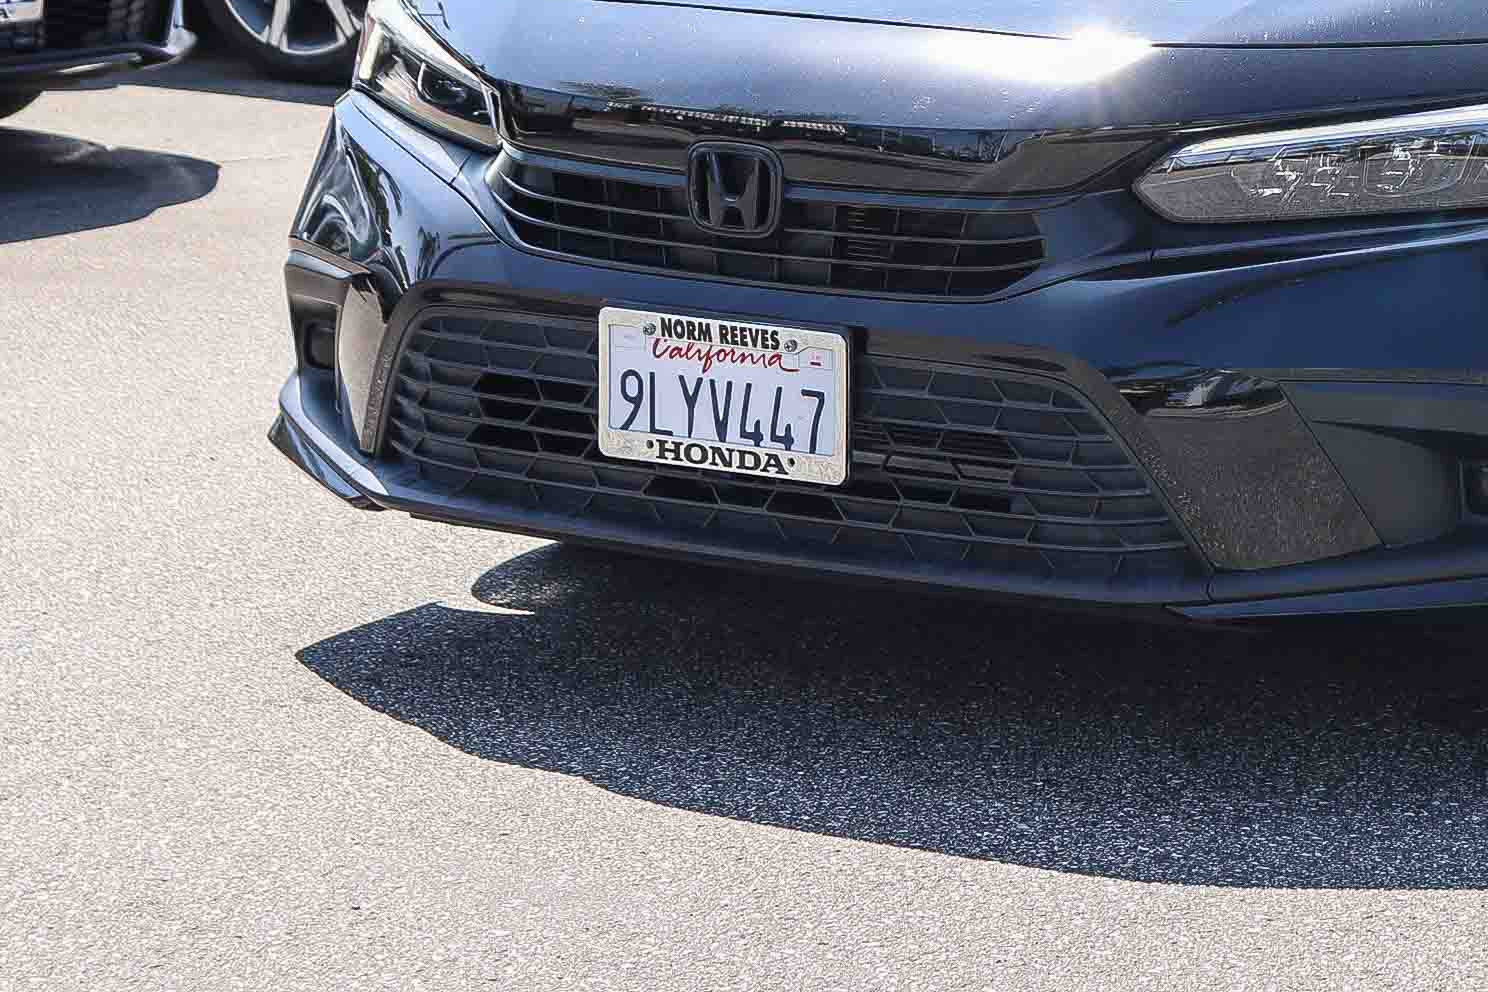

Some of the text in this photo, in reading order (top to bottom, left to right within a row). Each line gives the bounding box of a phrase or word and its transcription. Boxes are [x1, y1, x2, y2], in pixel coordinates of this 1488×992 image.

[660, 317, 781, 350] NORM REEVES
[652, 337, 799, 374] California
[620, 369, 825, 455] 9LYV447
[655, 439, 789, 475] HONDA
